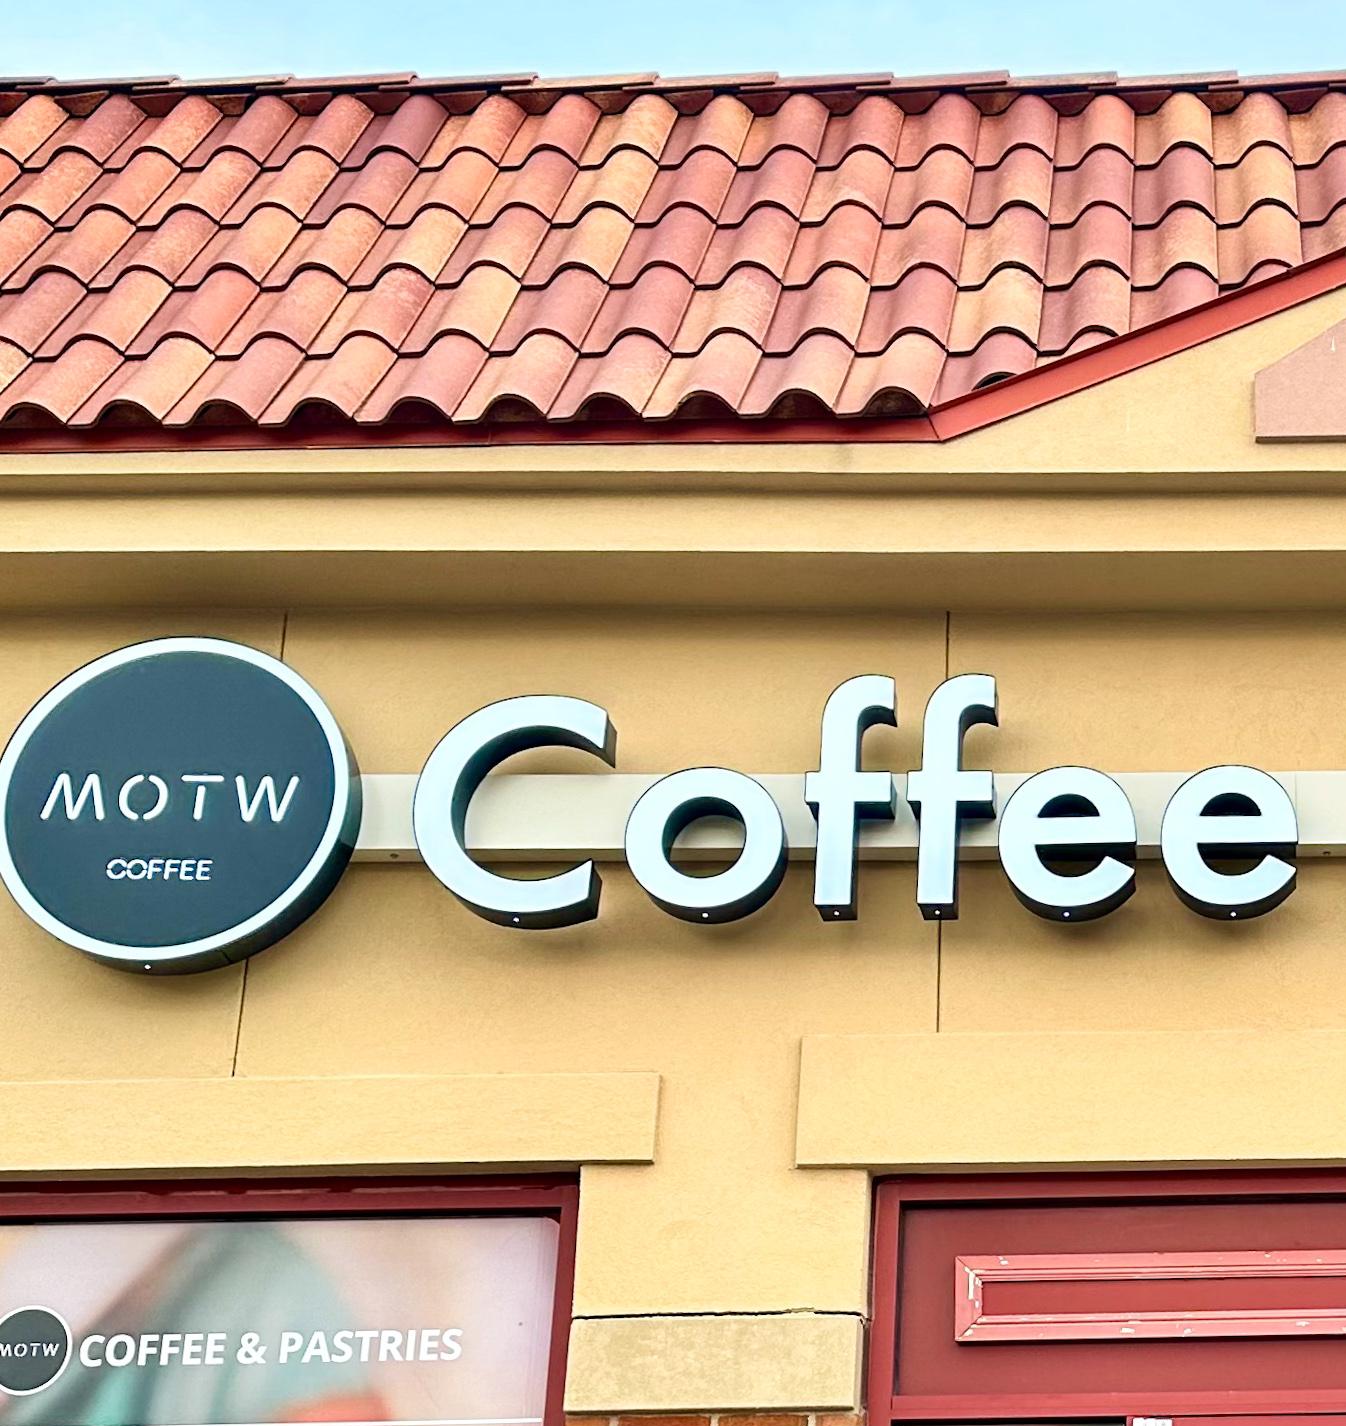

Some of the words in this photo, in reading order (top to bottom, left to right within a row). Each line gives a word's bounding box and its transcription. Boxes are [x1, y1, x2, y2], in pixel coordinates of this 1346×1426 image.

[40, 772, 301, 823] MOTW
[412, 672, 1298, 930] Coffee
[105, 857, 213, 882] COFFEE
[79, 1333, 226, 1368] COFFEE
[236, 1332, 267, 1365] &
[279, 1328, 464, 1364] PASTRIES
